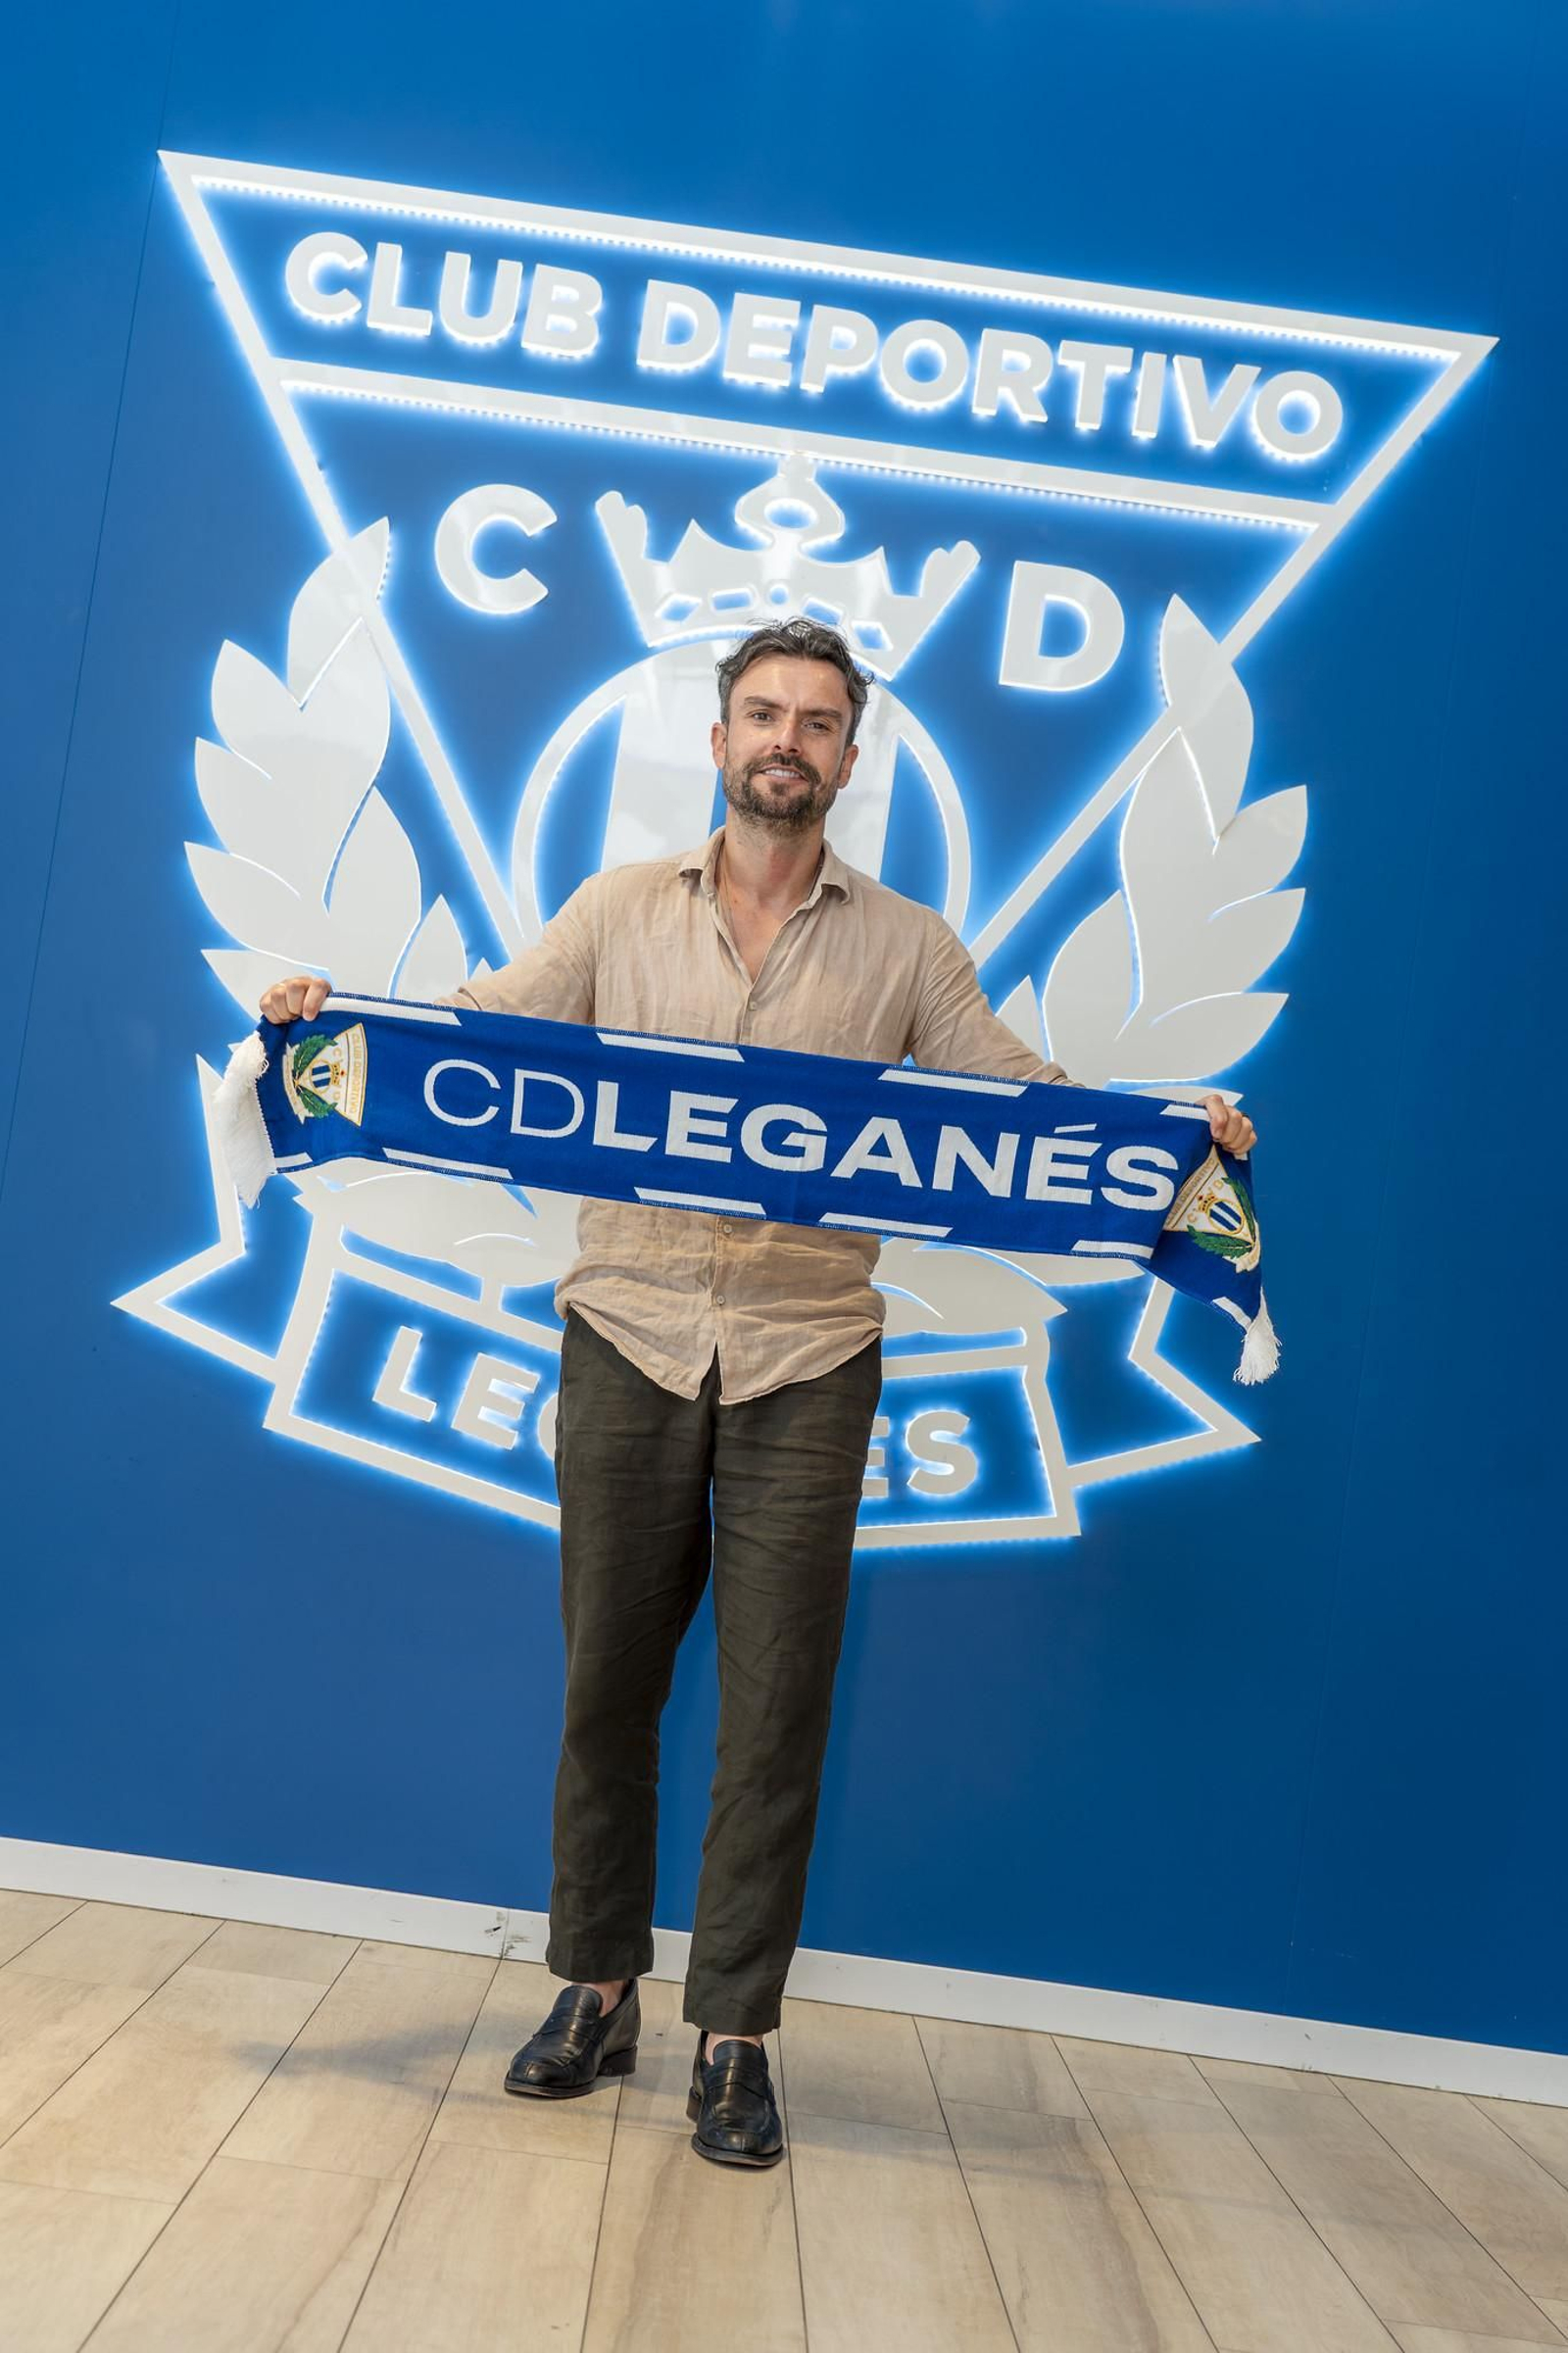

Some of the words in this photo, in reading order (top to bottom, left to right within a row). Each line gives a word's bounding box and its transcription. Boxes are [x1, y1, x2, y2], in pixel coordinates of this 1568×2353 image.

[285, 232, 604, 357] CLUB
[636, 278, 1344, 462] DEPORTIVO
[434, 484, 558, 614] C
[998, 560, 1125, 691] D
